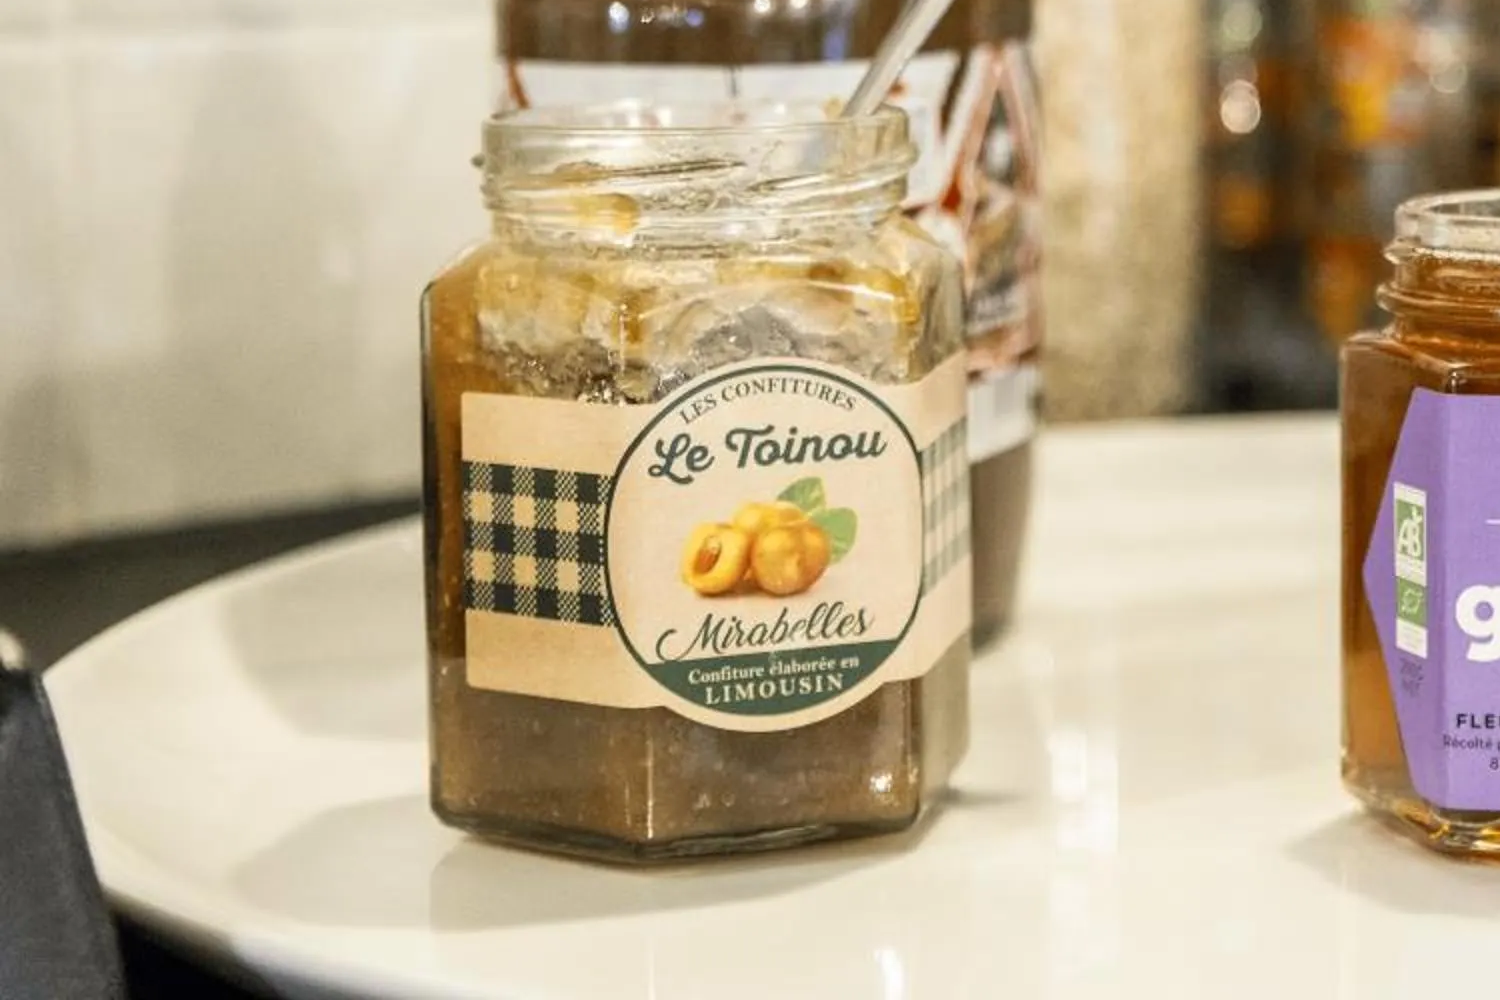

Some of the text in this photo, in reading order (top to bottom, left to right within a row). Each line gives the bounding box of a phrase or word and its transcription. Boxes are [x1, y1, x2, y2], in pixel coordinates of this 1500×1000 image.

[680, 377, 857, 424] LES CONFITURES
[648, 425, 887, 484] Le Toinou
[655, 601, 875, 662] Mirabelles
[688, 665, 765, 685] Confiture
[840, 656, 859, 669] en
[705, 673, 844, 705] LIMOUSIN
